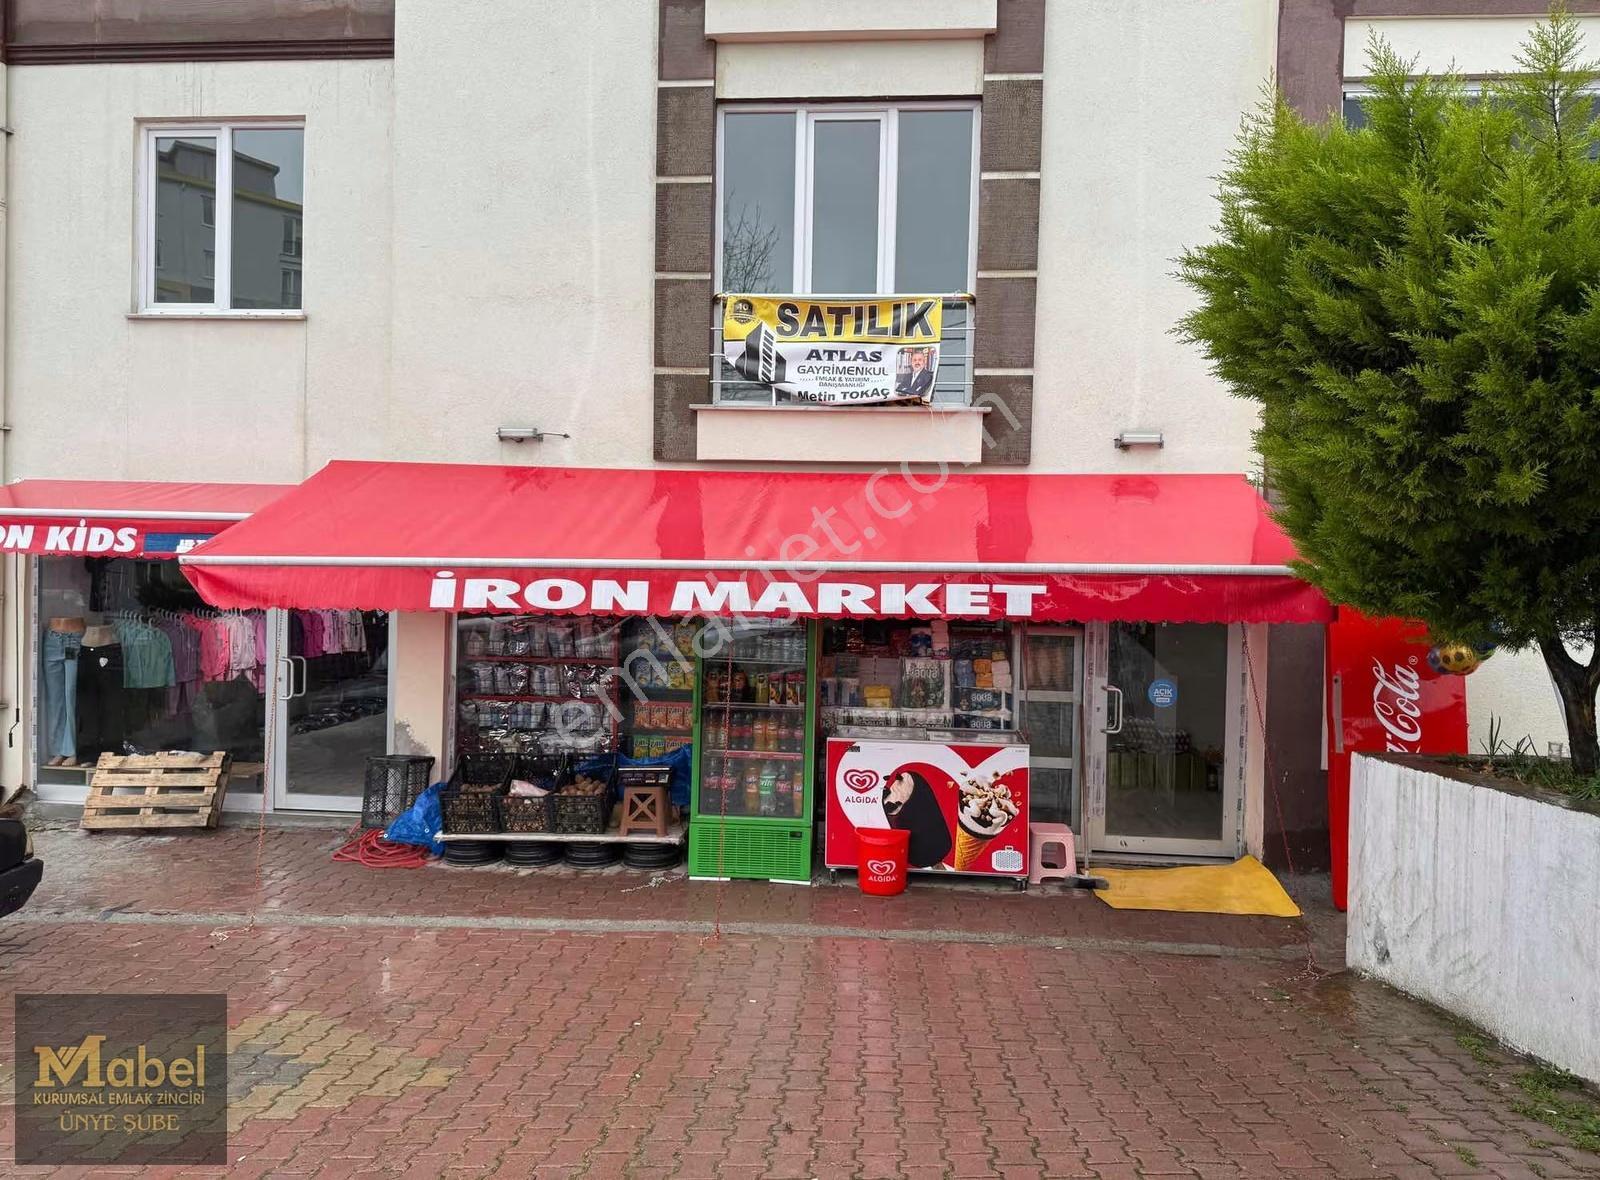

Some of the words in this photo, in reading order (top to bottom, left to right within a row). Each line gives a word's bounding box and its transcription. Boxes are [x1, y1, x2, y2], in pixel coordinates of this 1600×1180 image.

[776, 300, 937, 338] SATILIK
[805, 348, 883, 363] ATLAS
[797, 363, 889, 376] GAYRİMENKUL
[797, 390, 836, 402] Metin
[840, 387, 890, 400] TOKAÇ
[0, 524, 35, 549] N
[45, 519, 137, 552] KİDS
[429, 570, 650, 611] İRON
[670, 581, 1047, 616] MARKET
[845, 796, 877, 804] ALGIDA
